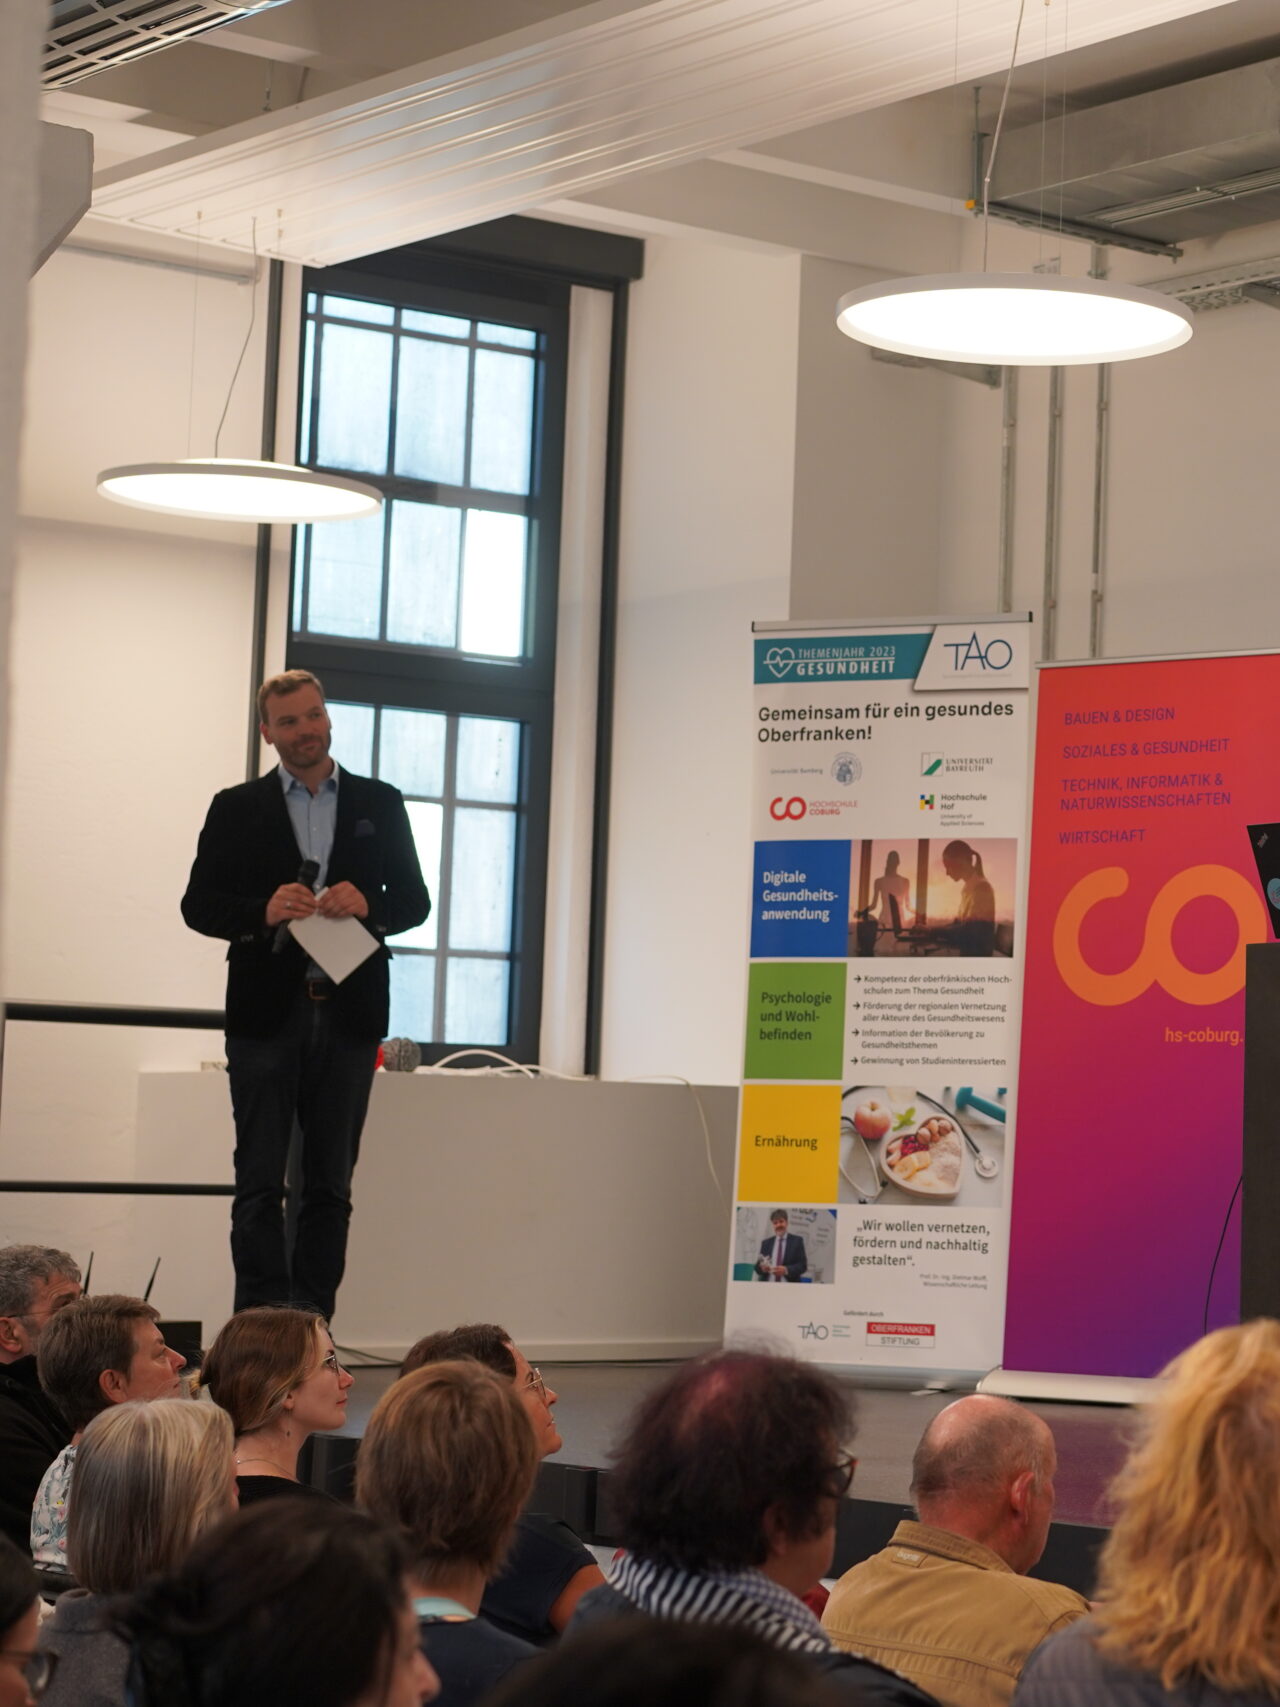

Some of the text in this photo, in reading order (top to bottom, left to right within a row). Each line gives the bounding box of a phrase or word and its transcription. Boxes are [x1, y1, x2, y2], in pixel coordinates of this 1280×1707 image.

[798, 646, 896, 659] THEMENJAHR 2023
[943, 631, 1013, 671] TAO
[796, 660, 896, 676] GESUNDHEIT
[758, 701, 1014, 722] Gemeinsam für ein gesundes
[1064, 708, 1175, 726] BAUEN & DESIGN
[758, 725, 873, 743] Oberfranken!
[1063, 738, 1230, 759] SOZIALES & GESUNDHEIT
[1061, 773, 1223, 792] TECHNIK, INFORMATIK &
[941, 793, 987, 801] Hochschule
[1060, 792, 1231, 810] NATURWISSENSCHAFTEN
[809, 808, 840, 816] COBURG
[1059, 829, 1146, 845] WIRTSCHAFT
[763, 871, 807, 887] Digitale
[762, 889, 839, 903] Gesundheits-
[761, 908, 830, 923] anwendung
[864, 975, 907, 984] Kompetenz
[908, 974, 922, 983] der
[923, 974, 986, 983] oberfränkischen
[863, 987, 985, 995] schulen zum Thema Gesundheit
[761, 992, 832, 1007] Psychologie
[863, 1001, 1007, 1012] Förderung der regionalen Vernetzung
[760, 1010, 820, 1022] und Wohl-
[862, 1014, 1005, 1023] aller Akteure des Gesundheitswesens
[759, 1028, 812, 1041] befinden
[861, 1041, 938, 1049] Gesundheitsthemen
[860, 1057, 904, 1065] Gewinnung
[905, 1057, 920, 1065] von
[754, 1135, 818, 1150] Ernährung
[885, 1220, 924, 1232] wollen
[927, 1223, 991, 1236] vernetzen,
[853, 1236, 989, 1254] fördern und nachhaltig
[797, 1321, 829, 1340] TAO
[871, 1324, 931, 1334] OBERFRANKEN
[881, 1336, 920, 1346] STIFTUNG
